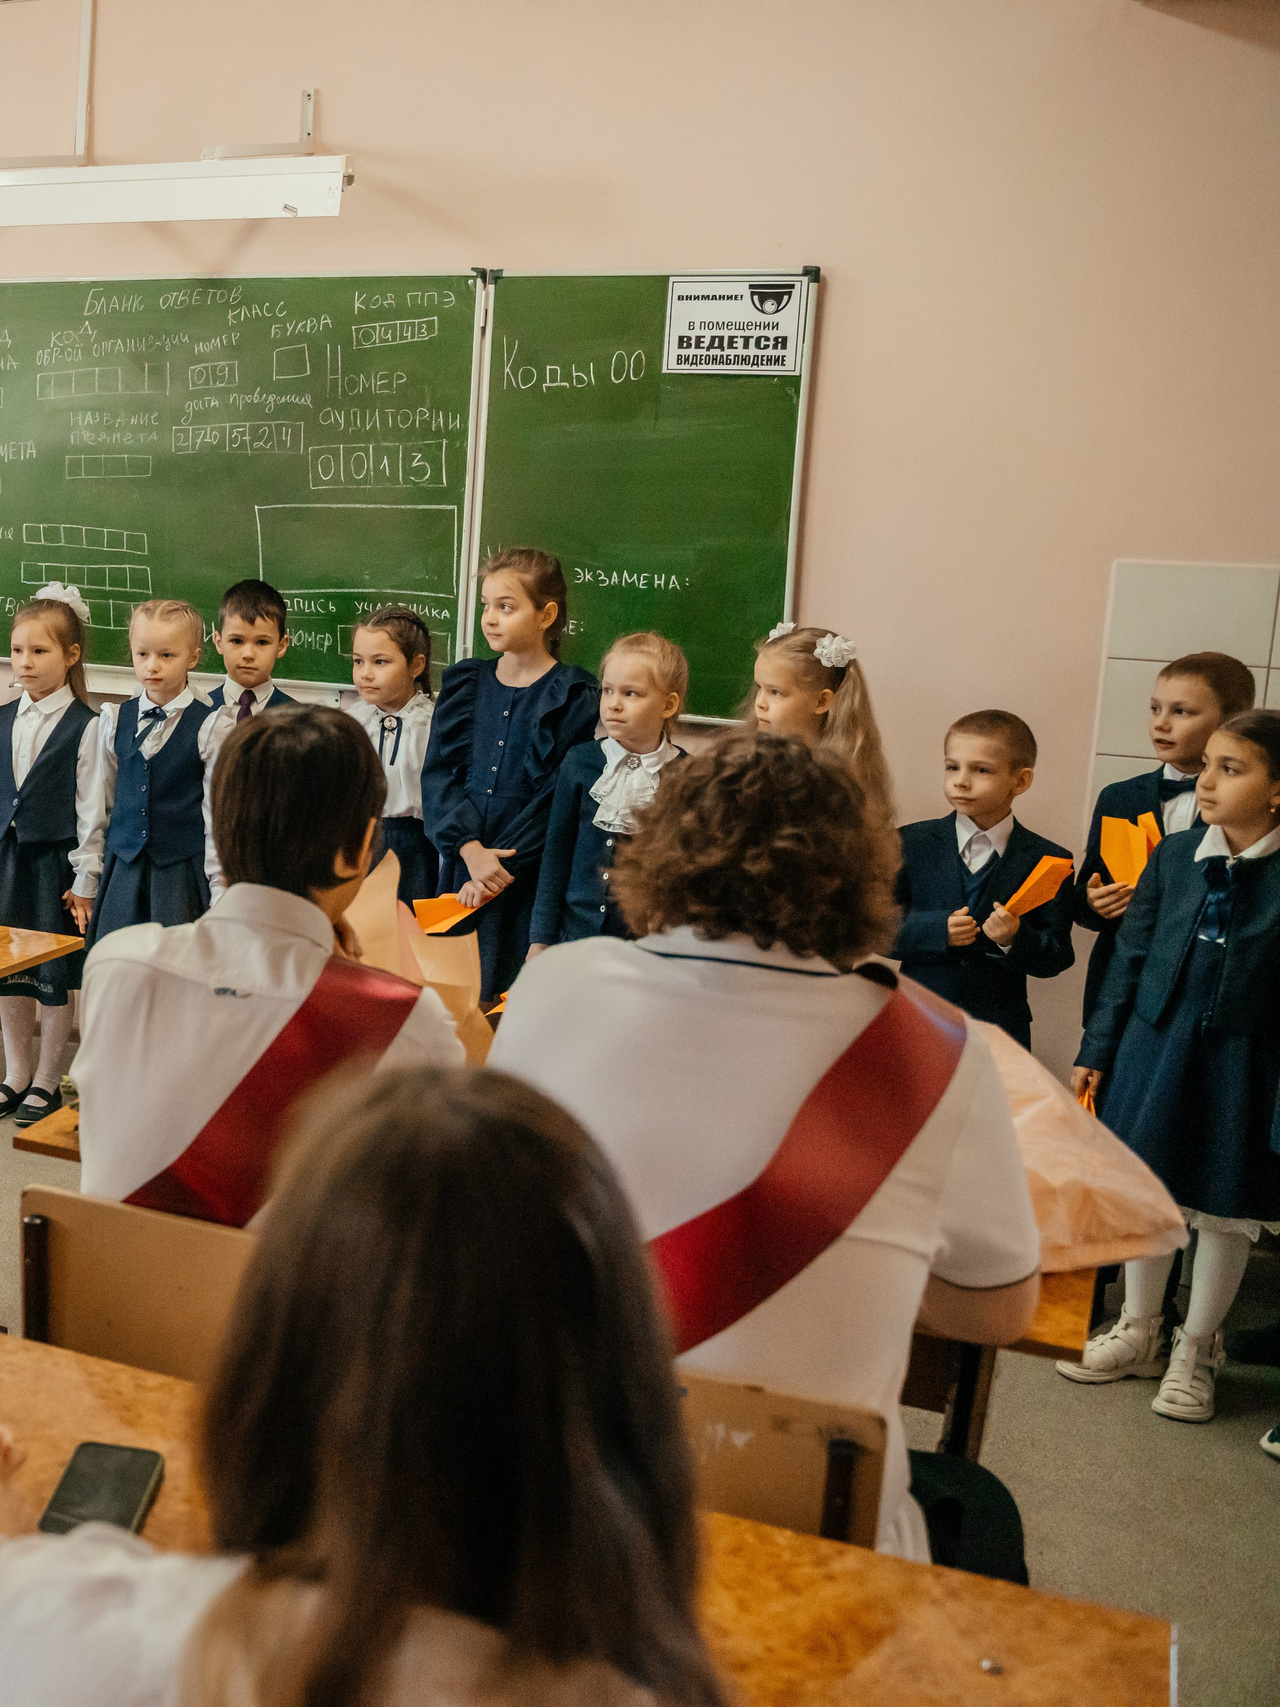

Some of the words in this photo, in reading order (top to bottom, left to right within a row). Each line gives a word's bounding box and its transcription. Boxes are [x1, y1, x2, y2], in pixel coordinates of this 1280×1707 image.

[353, 290, 397, 315] КОД
[406, 290, 456, 308] ППЭ
[676, 293, 745, 302] ВНИМАНИЕ!
[227, 301, 288, 327] КЛАСС
[270, 313, 333, 340] БУКВА
[687, 320, 696, 331] в
[698, 320, 780, 333] помещении
[676, 334, 789, 352] ВЕДЕТСЯ
[675, 353, 787, 368] ВИДЕОНАБЛЮДЕНИЕ
[573, 566, 691, 591] ЭКЗАМЕНА:
